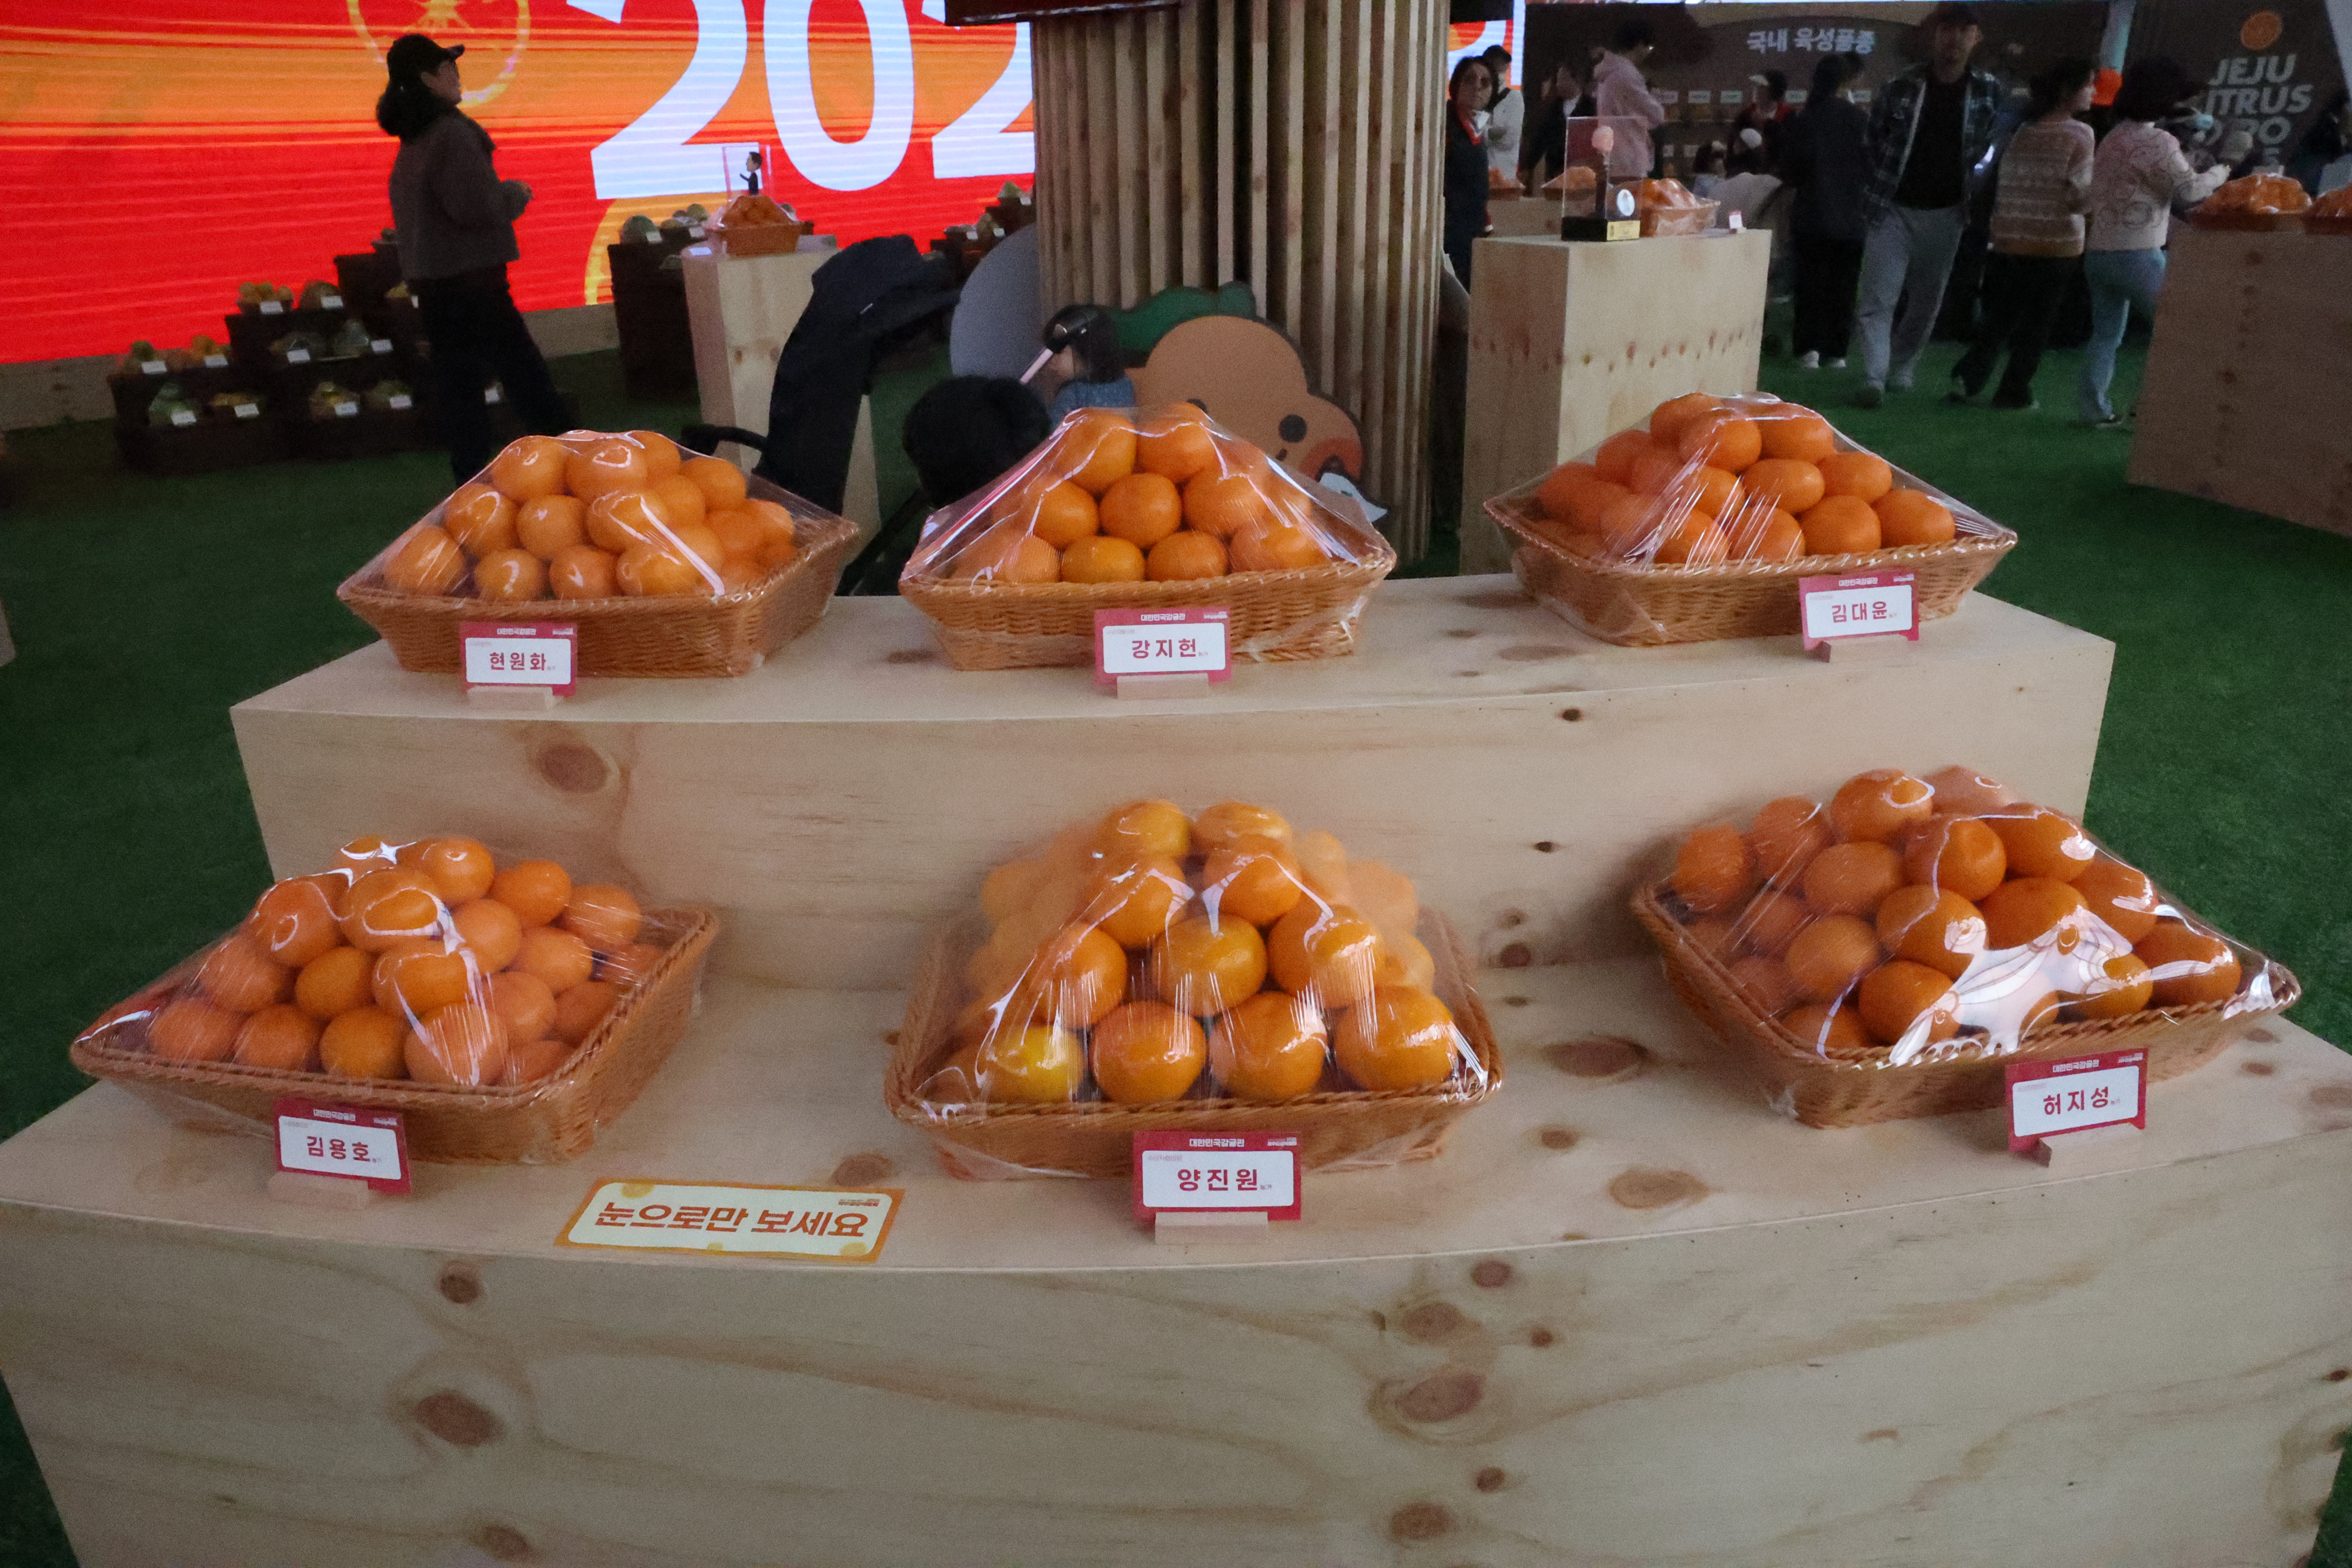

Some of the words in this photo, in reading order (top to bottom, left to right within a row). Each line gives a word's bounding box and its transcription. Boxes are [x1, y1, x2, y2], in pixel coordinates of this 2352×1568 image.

[1747, 28, 1788, 54] 국내
[2208, 53, 2296, 86] JEJU
[2205, 85, 2314, 115] ITRUS
[1832, 601, 1887, 623] 김대윤
[490, 652, 546, 671] 현원화
[1132, 639, 1196, 659] 강지헌
[2043, 1086, 2109, 1115] 허지성
[307, 1136, 370, 1162] 김용호
[1178, 1169, 1258, 1191] 양진원
[595, 1202, 748, 1232] 눈으로만
[751, 1210, 869, 1237] 보세요
